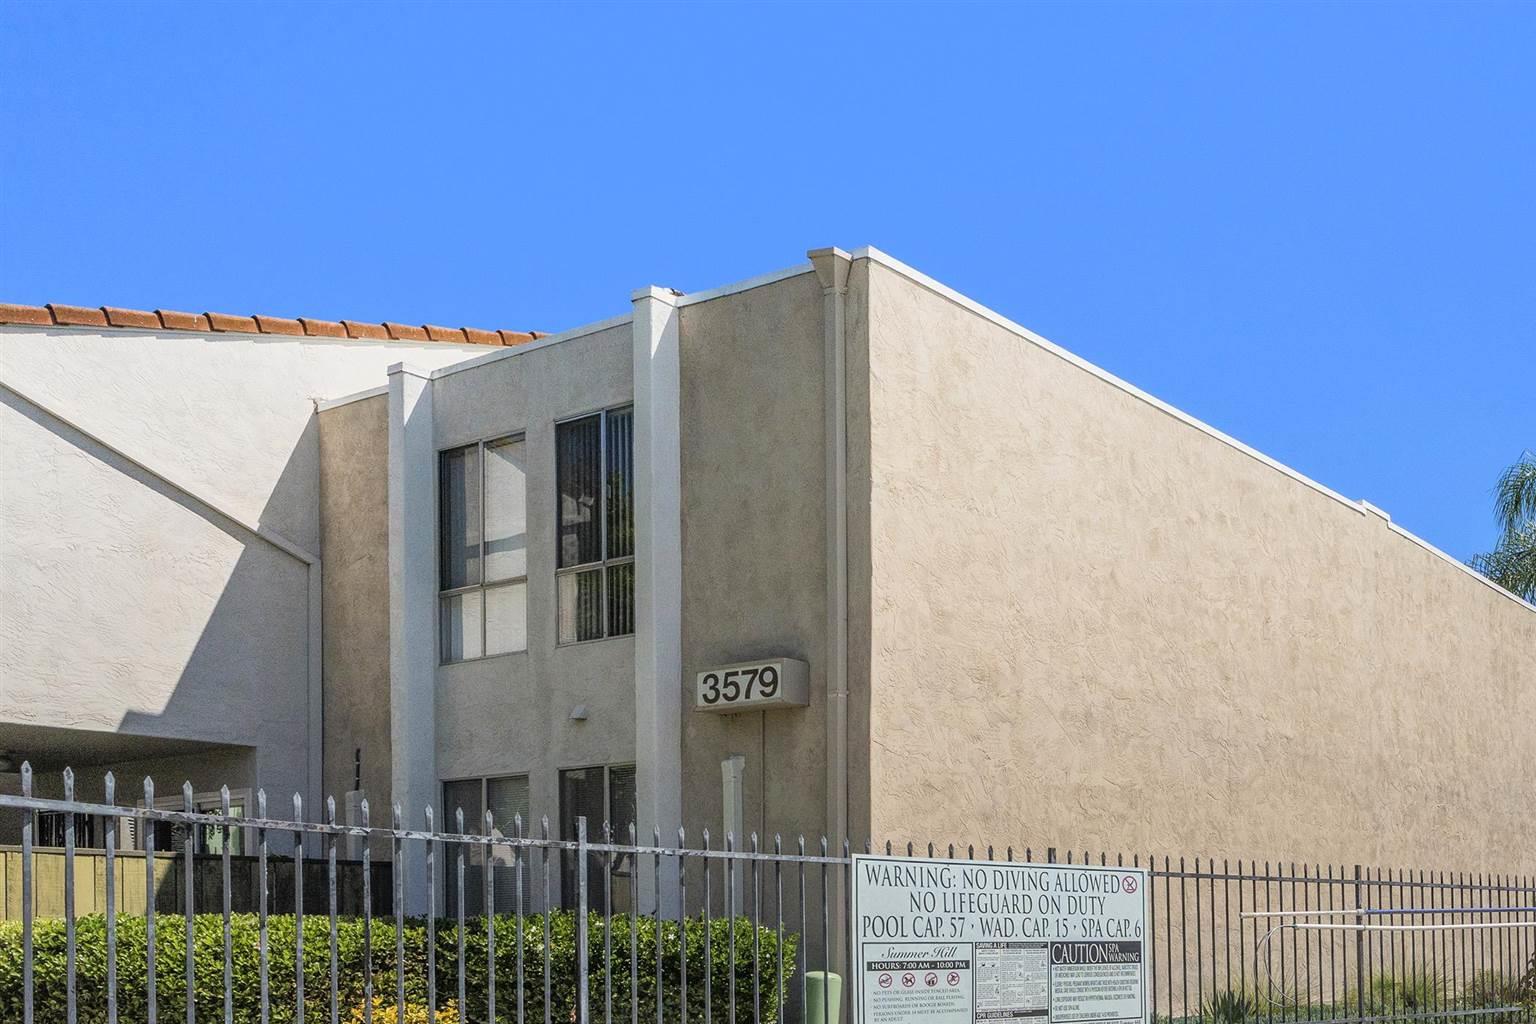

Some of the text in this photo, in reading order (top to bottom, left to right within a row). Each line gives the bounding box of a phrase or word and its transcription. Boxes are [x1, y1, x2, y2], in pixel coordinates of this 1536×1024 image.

[702, 666, 778, 704] 3579
[865, 864, 1120, 894] WARNING: NO DIVING ALLOWED
[910, 891, 1106, 915] NO LIFEGUARD ON DUTY
[862, 915, 1142, 938] POOL CAP. 57 WAD. CAP. 15 SPA CAP. 6
[881, 945, 958, 959] Summer Hill
[1052, 943, 1120, 964] CAUTION SPA
[1108, 952, 1140, 962] WARNING
[871, 962, 902, 970] HOURS:
[903, 962, 917, 970] 7:00
[936, 961, 954, 969] 10:00
[955, 961, 967, 969] PM
